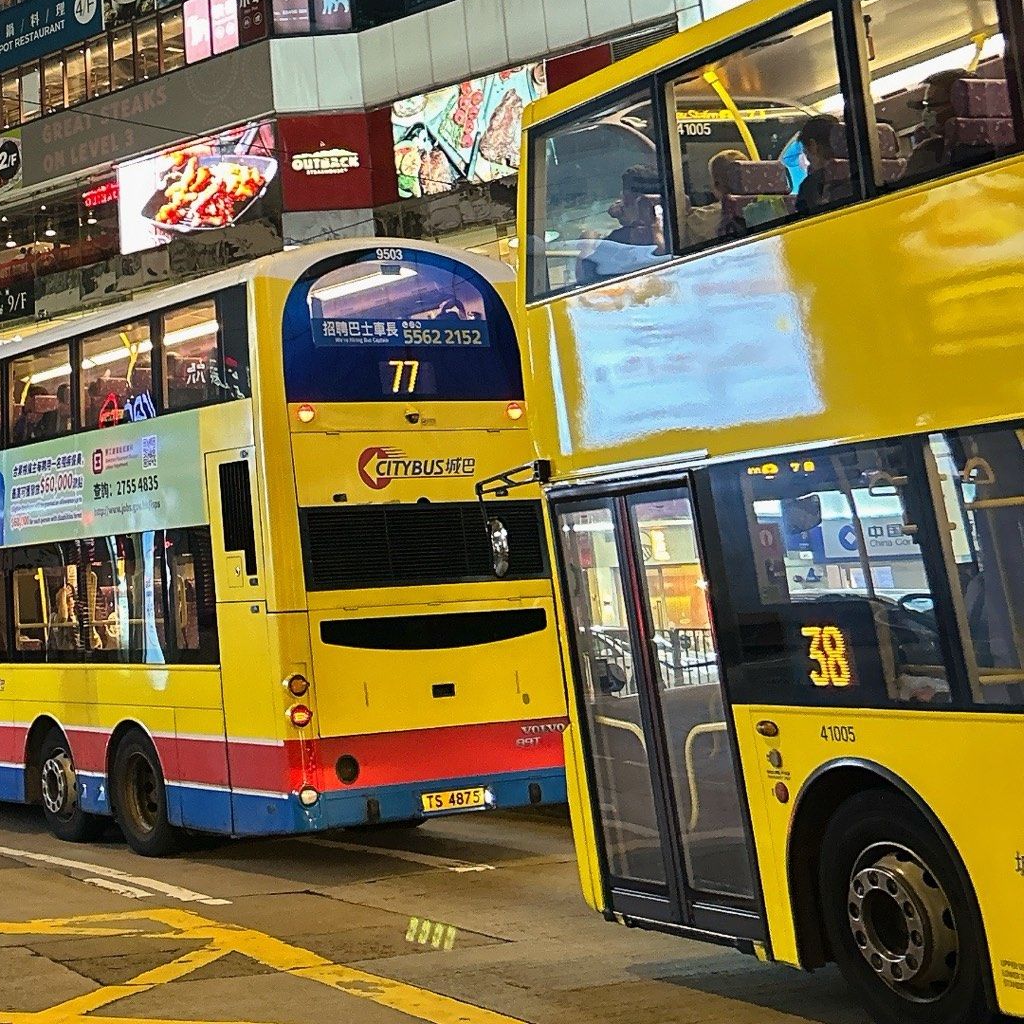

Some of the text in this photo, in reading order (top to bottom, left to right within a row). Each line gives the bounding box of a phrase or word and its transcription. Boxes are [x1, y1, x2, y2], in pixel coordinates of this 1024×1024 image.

[15, 19, 65, 49] RESTAURANT
[43, 85, 166, 144] GREAT STEAKS
[678, 122, 712, 136] 41005
[44, 150, 64, 173] ON
[71, 134, 119, 164] LEVEL
[291, 157, 360, 171] OUTBACK
[376, 248, 403, 260] 9503
[8, 292, 27, 312] 9/F
[322, 320, 398, 338] 招聘巴士車長
[404, 329, 482, 345] 5562 2152
[389, 360, 419, 394] 77
[376, 457, 476, 476] CITYBUS 城巴
[117, 478, 137, 495] 2755
[137, 475, 159, 493] 4835
[800, 626, 853, 687] 38
[521, 722, 566, 734] VOLVO
[820, 725, 856, 743] 41005
[426, 791, 481, 809] TS 4875
